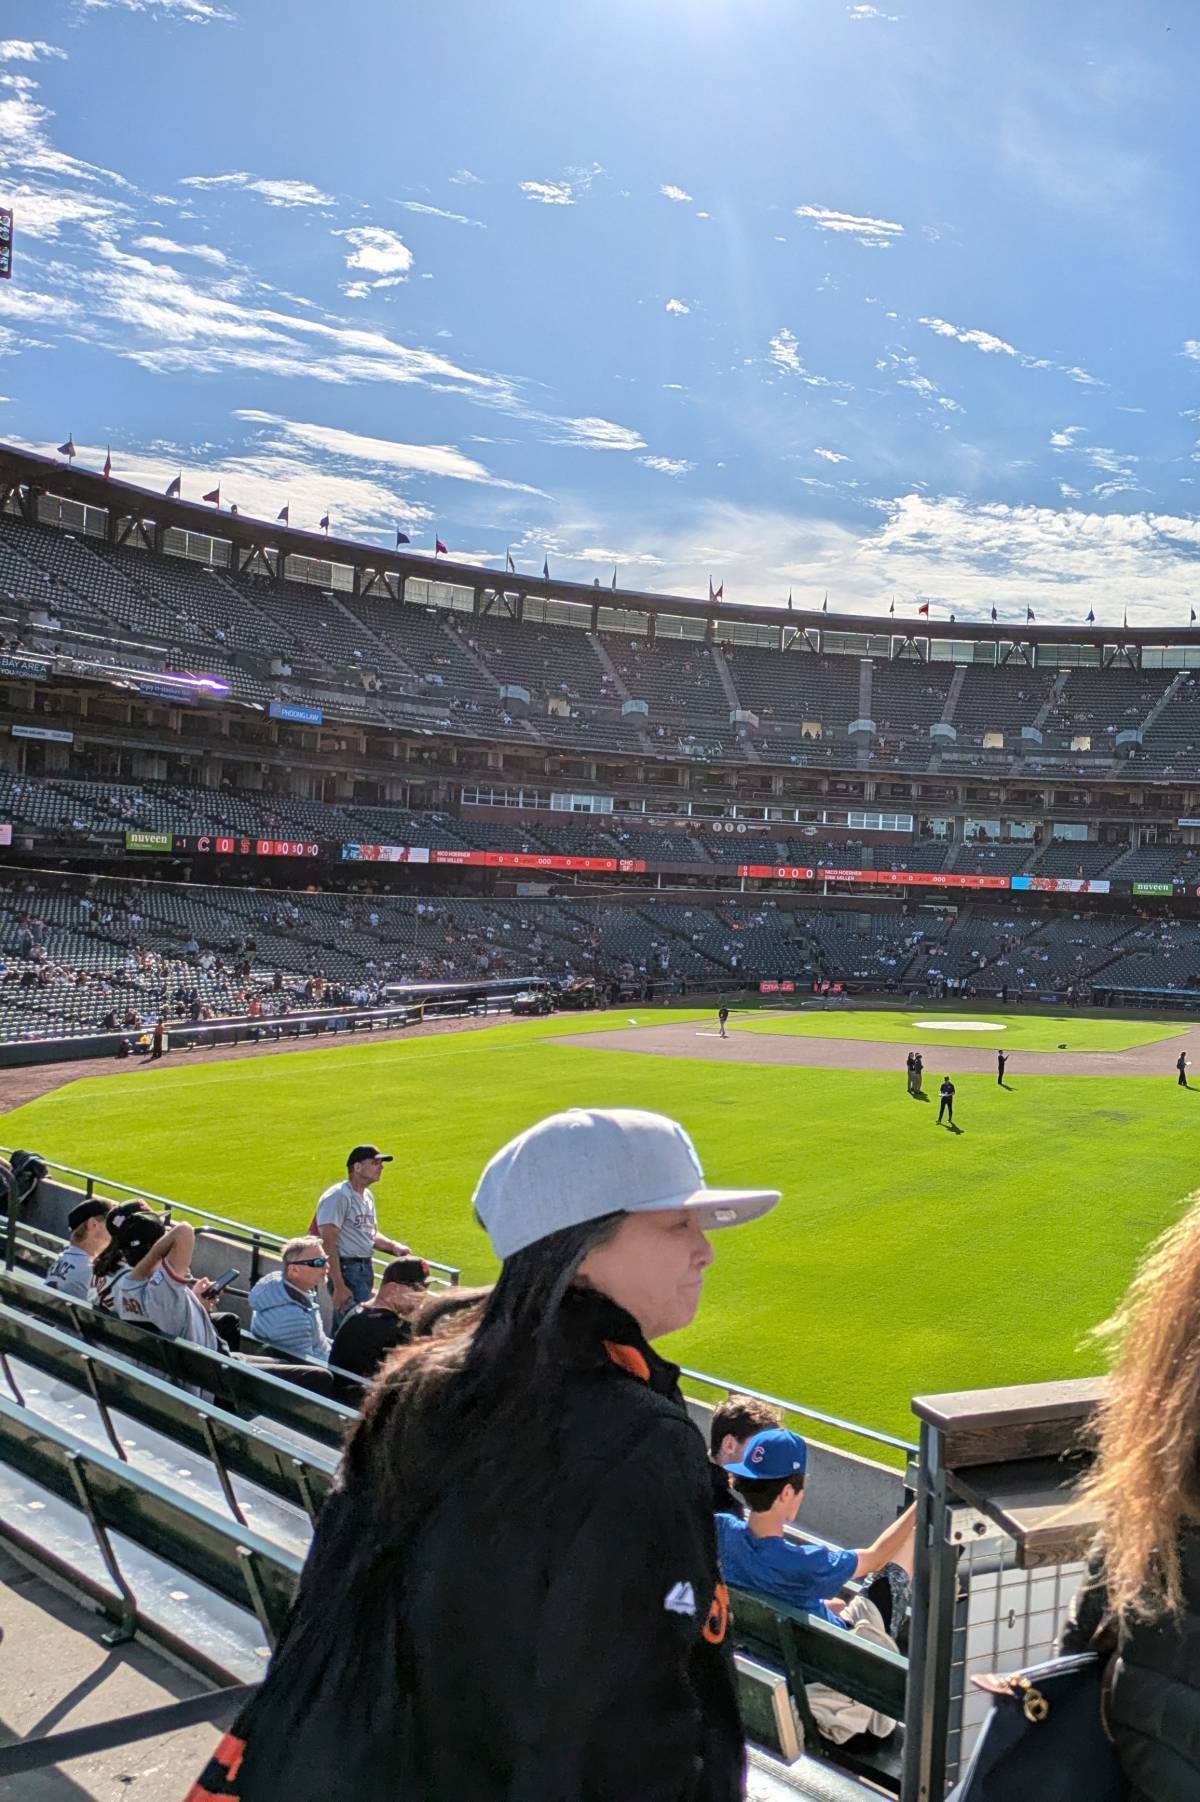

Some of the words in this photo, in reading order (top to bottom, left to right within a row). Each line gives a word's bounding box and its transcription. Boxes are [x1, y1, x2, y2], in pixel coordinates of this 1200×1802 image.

[2, 658, 20, 670] BAY
[21, 661, 47, 672] AREA
[131, 834, 168, 844] nuveen
[222, 839, 229, 851] 0
[262, 841, 269, 854] 0
[778, 868, 785, 877] 0
[792, 869, 799, 877] 0
[806, 870, 813, 878] 0
[751, 1446, 765, 1463] C
